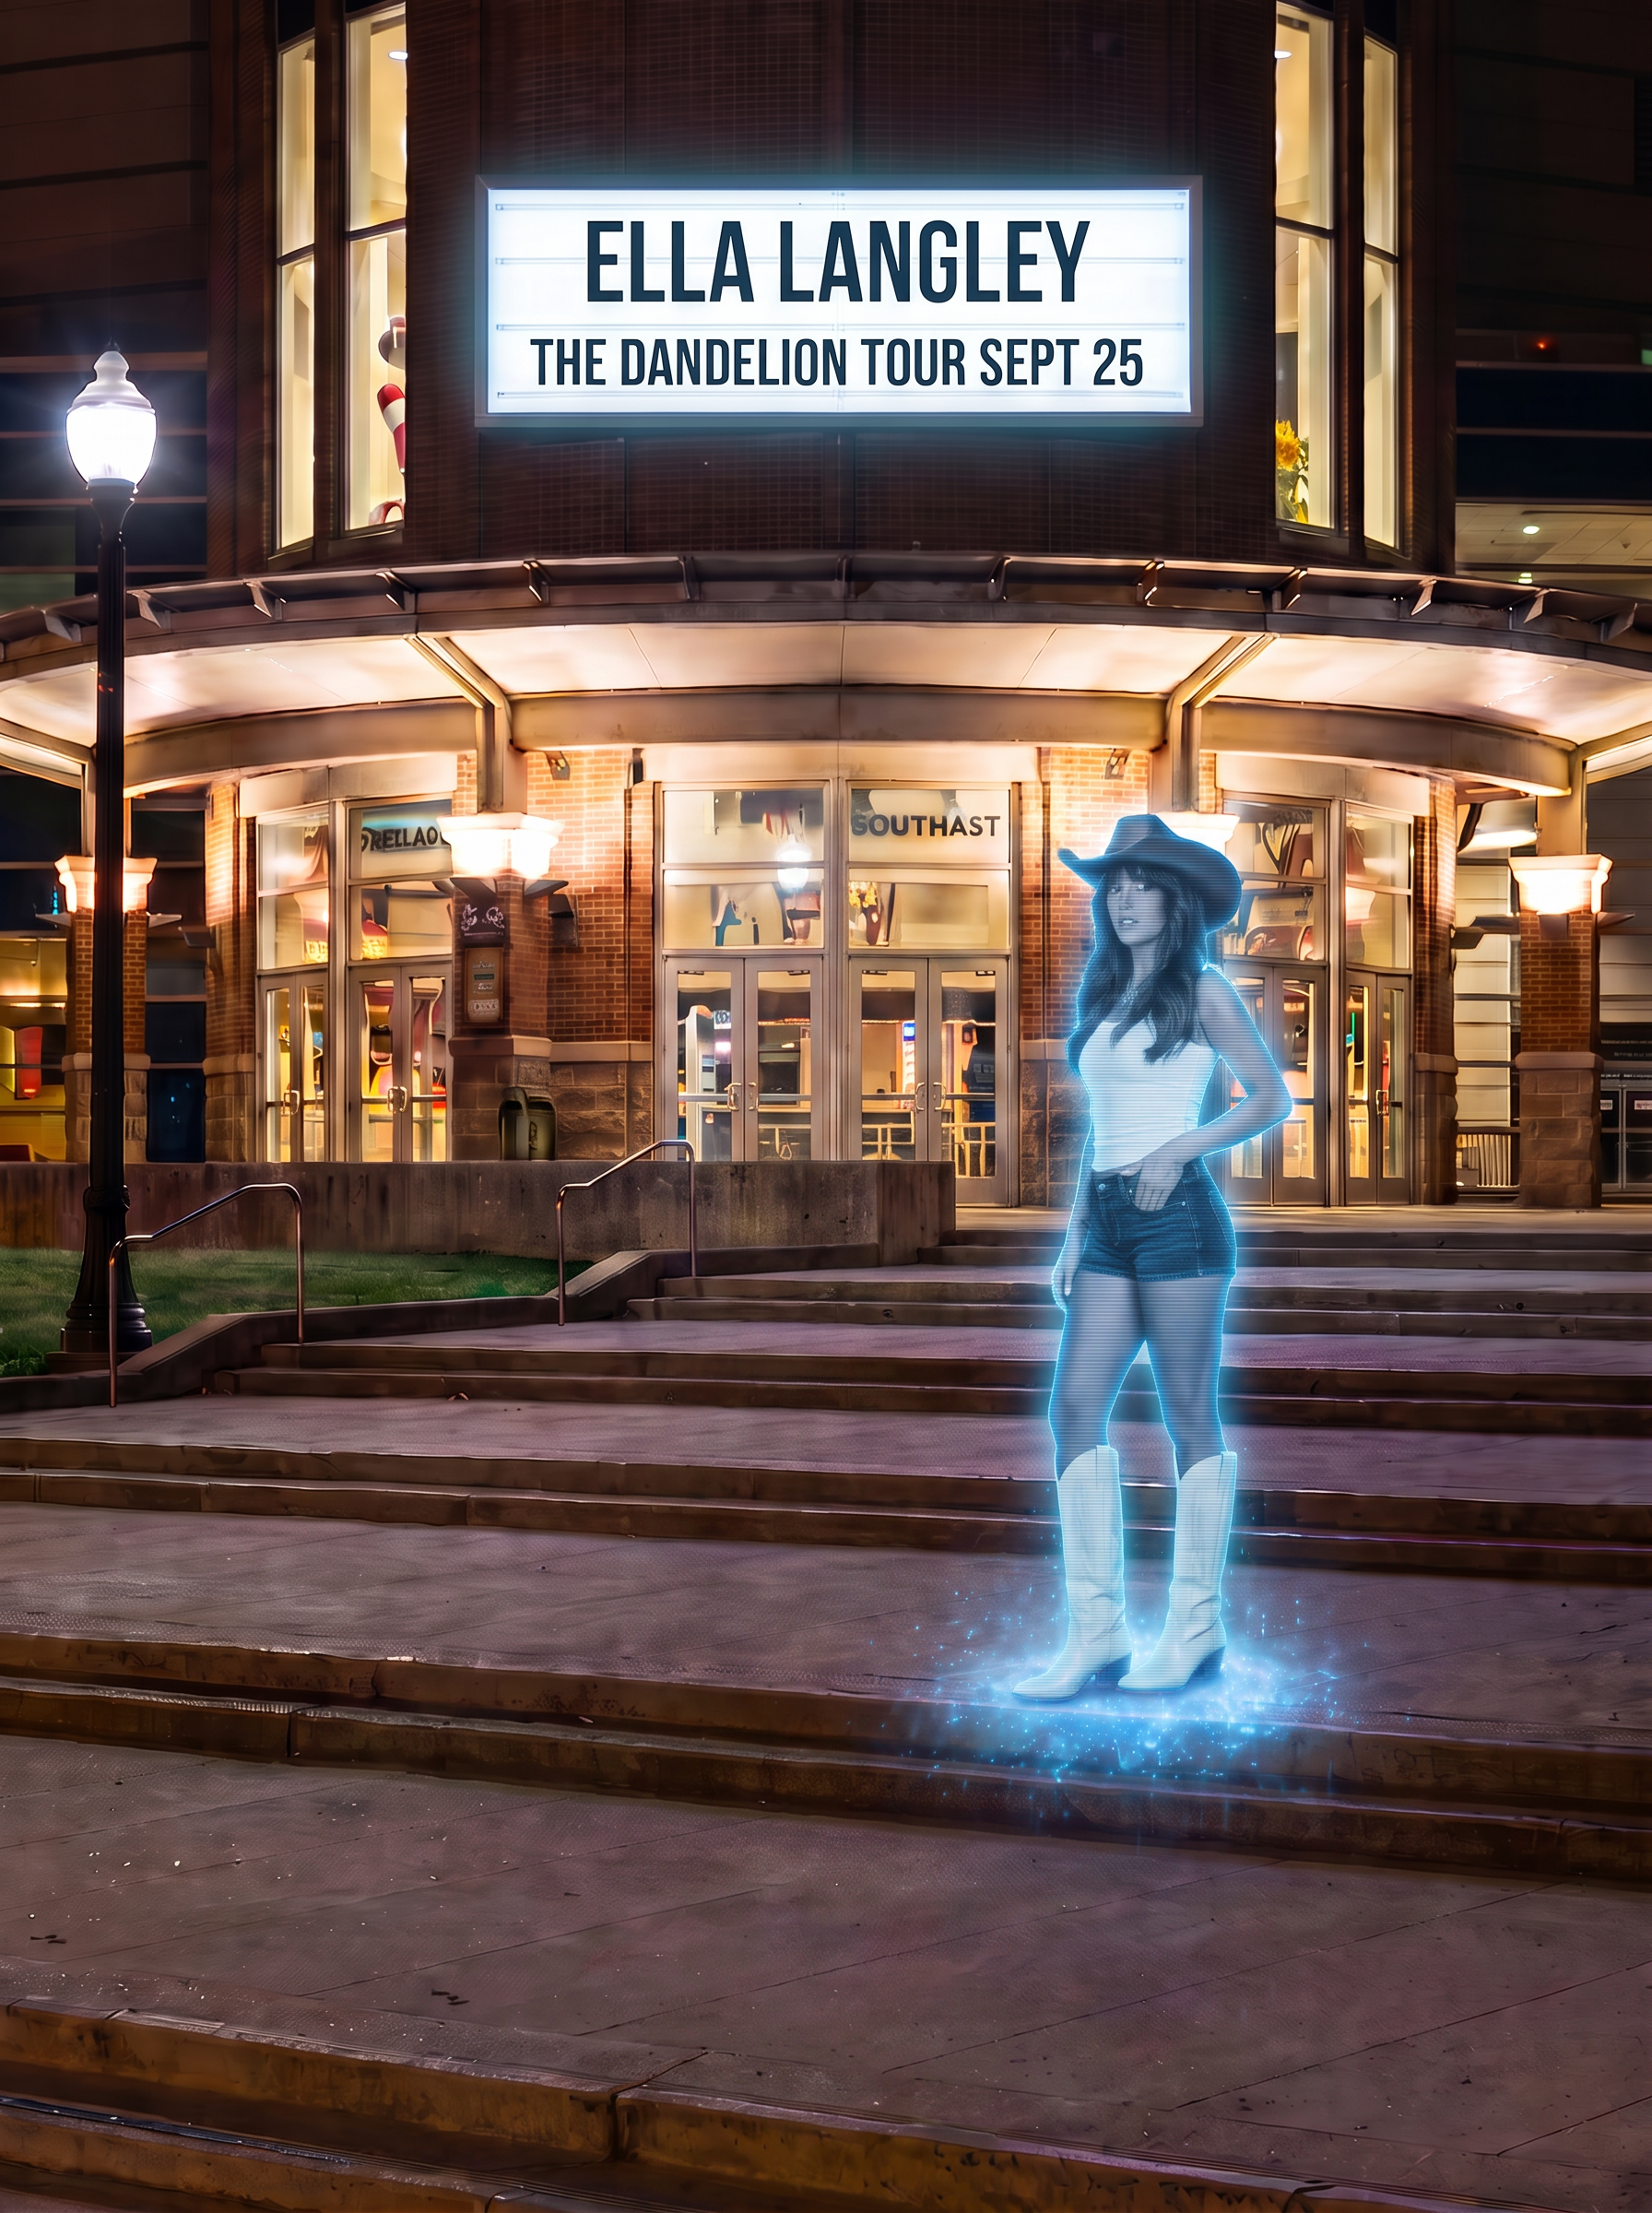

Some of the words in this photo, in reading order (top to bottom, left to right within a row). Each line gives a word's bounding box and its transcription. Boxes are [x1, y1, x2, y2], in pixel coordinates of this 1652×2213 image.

[587, 219, 754, 302] ELLA
[780, 219, 1090, 302] LANGLEY
[530, 337, 606, 385] THE
[620, 337, 845, 385] DANDELION
[860, 337, 964, 385] TOUR
[980, 337, 1080, 385] SEPT
[1093, 337, 1142, 385] 25
[851, 814, 1000, 836] SOUTHAST
